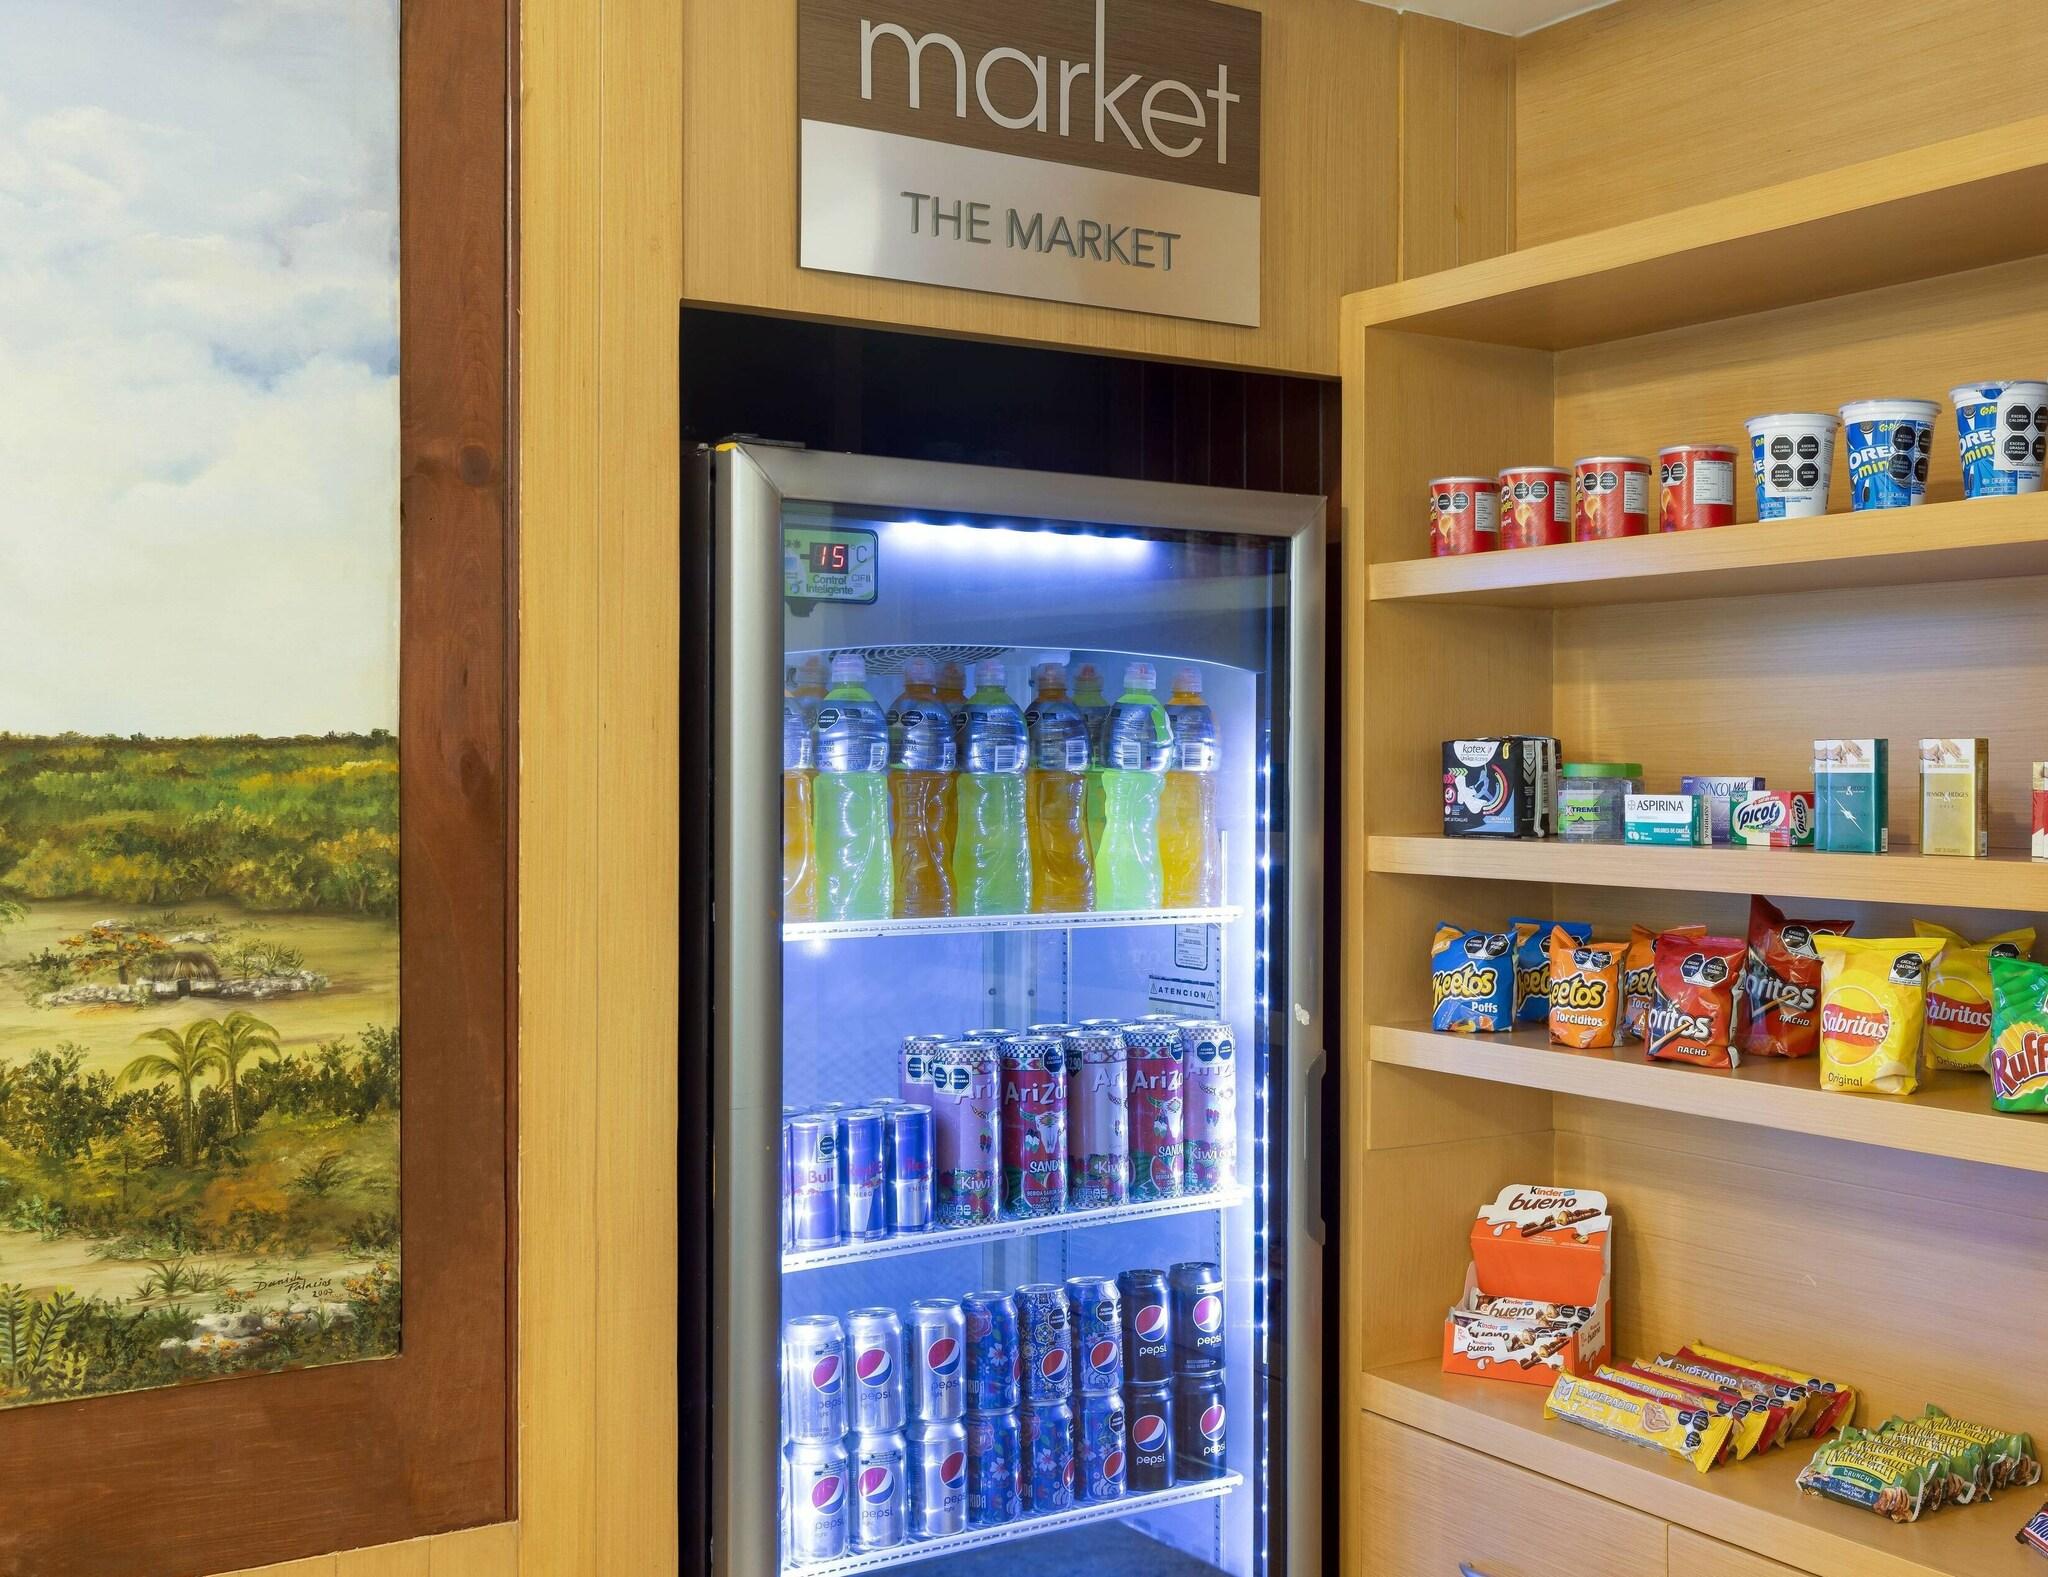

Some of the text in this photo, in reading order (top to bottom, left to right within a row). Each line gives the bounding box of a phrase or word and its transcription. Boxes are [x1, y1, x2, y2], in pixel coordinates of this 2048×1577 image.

[861, 0, 1240, 164] market
[900, 191, 1182, 271] THE MARKET
[1965, 444, 1995, 464] min
[1859, 460, 1888, 478] min
[820, 545, 846, 568] 15
[812, 574, 847, 586] Control
[806, 584, 854, 595] Inteligente
[1462, 744, 1487, 754] kotex
[1699, 780, 1748, 797] SYNCOL MAX
[1564, 805, 1600, 816] XTREME
[1637, 800, 1684, 812] ASPIRINA
[1158, 986, 1206, 999] ATENCION
[1746, 971, 1817, 1011] oritos
[1471, 1001, 1498, 1014] Poffs
[1556, 1010, 1603, 1026] Torciditos
[1649, 1003, 1714, 1040] oritos
[1822, 1009, 1888, 1041] Sabritas
[1991, 1031, 2048, 1098] Ruff
[1828, 1072, 1863, 1087] Original
[808, 1168, 834, 1184] Bull
[1530, 1186, 1563, 1197] Kinder
[1508, 1192, 1577, 1211] bueno
[1503, 1298, 1524, 1306] Kinder
[1490, 1303, 1535, 1318] bueno
[1477, 1321, 1498, 1330] Kinder
[1197, 1333, 1222, 1347] pepsi
[1139, 1343, 1168, 1357] pepsi
[1467, 1344, 1495, 1352] bueno
[1675, 1362, 1737, 1387] EMPERADOR
[860, 1390, 891, 1402] pepsi
[1578, 1385, 1641, 1414] EMPERADOR
[1136, 1452, 1166, 1467] pepsi
[1830, 1449, 1865, 1467] NATURE
[1843, 1468, 1873, 1484] CRUNCHY
[861, 1505, 893, 1520] pepsi
